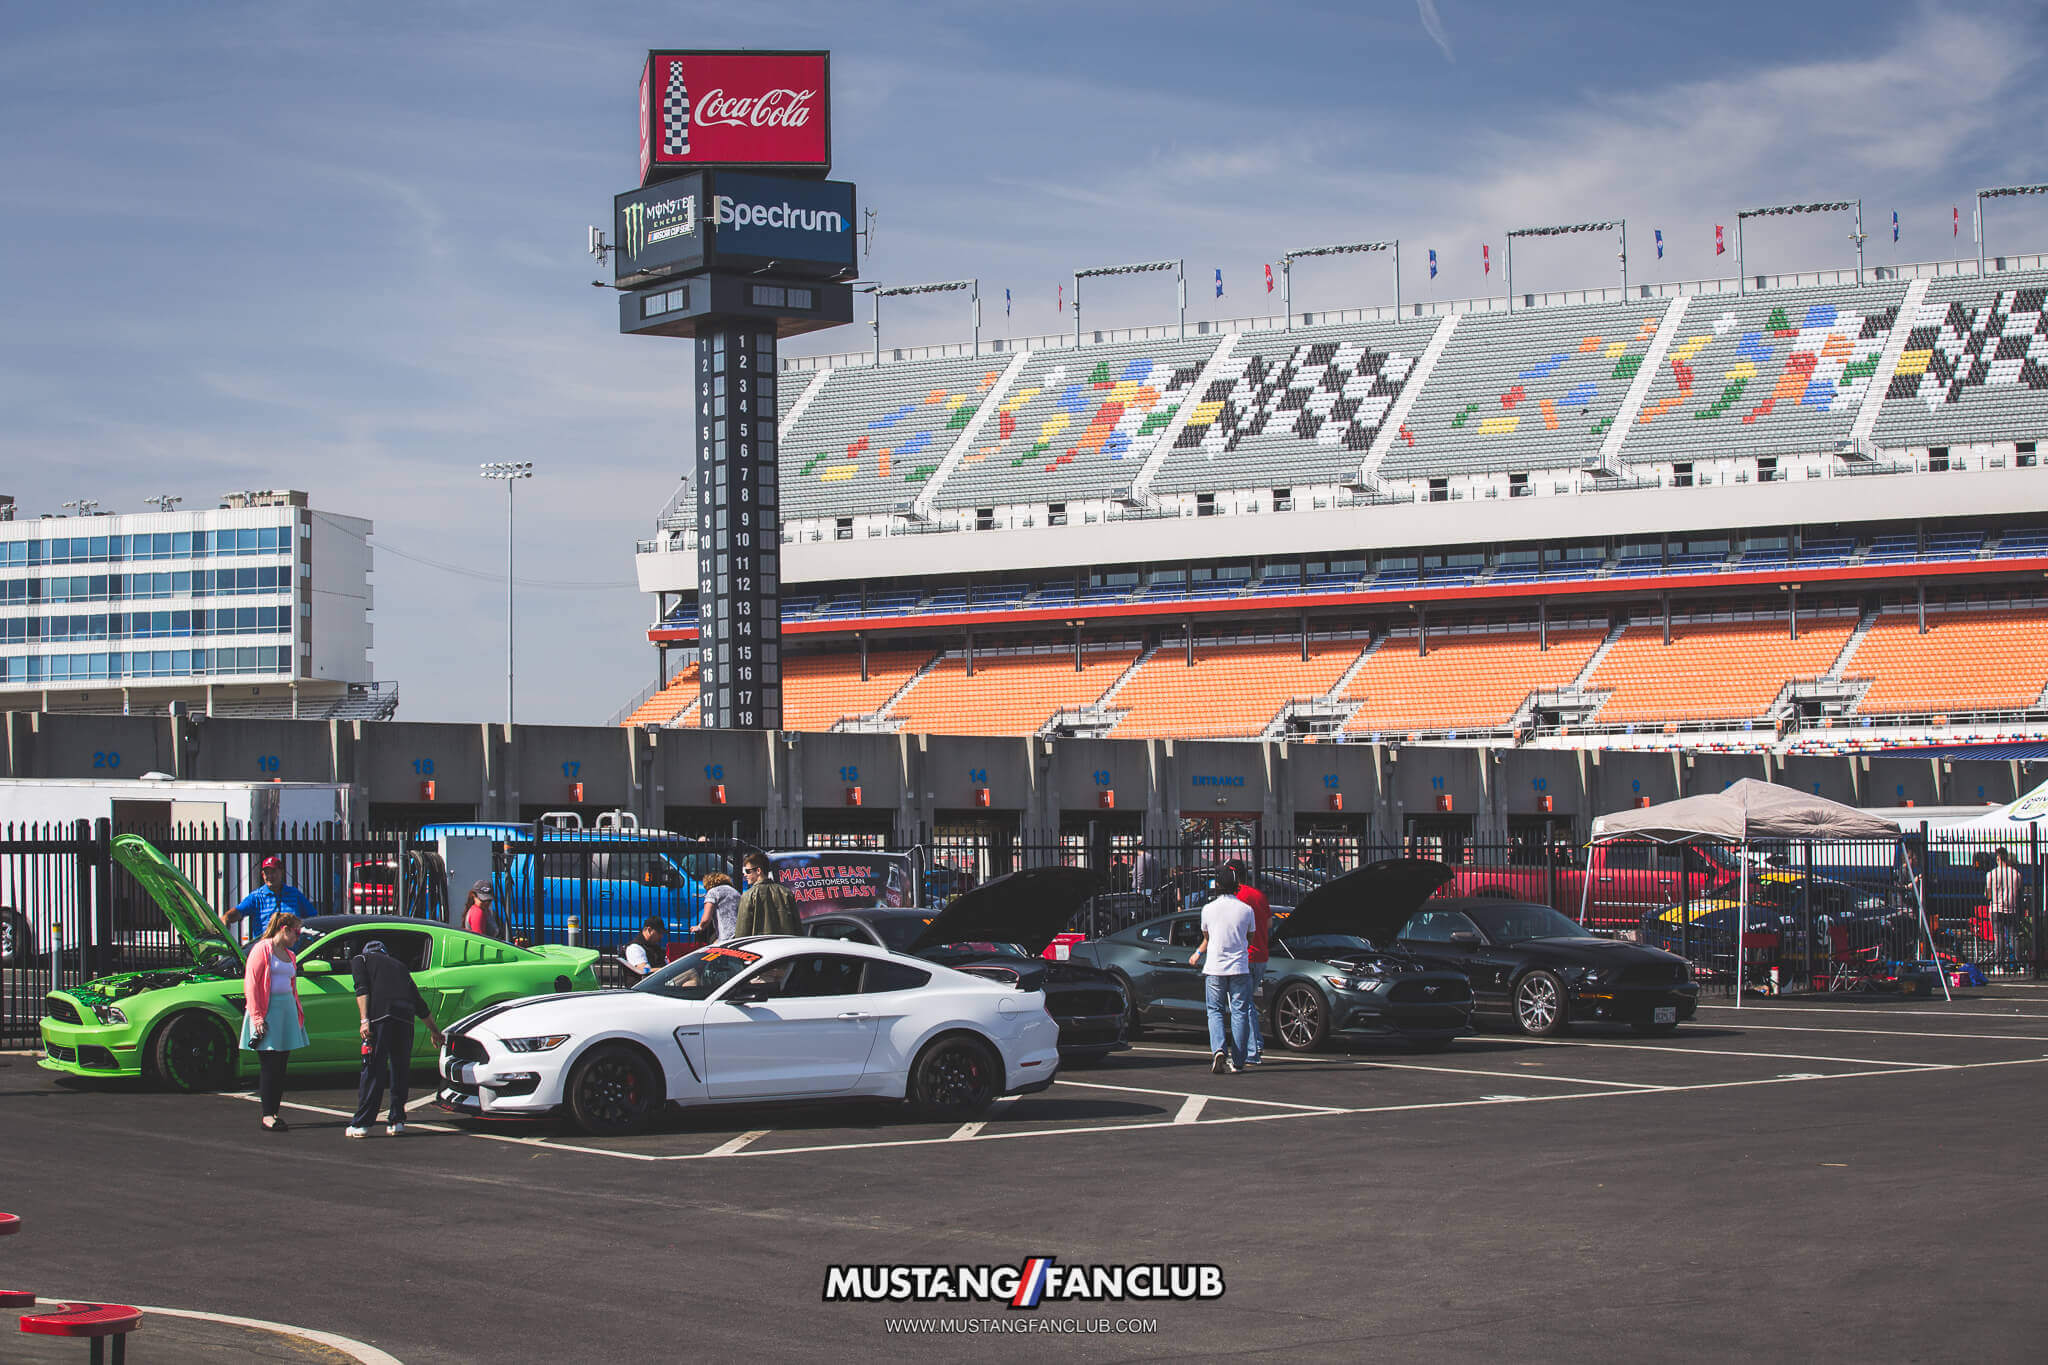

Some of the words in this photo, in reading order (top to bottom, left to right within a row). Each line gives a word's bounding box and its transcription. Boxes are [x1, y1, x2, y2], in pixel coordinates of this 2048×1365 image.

[694, 88, 817, 127] Coca-Cola
[646, 196, 694, 219] MONSTE
[718, 195, 842, 233] Spectrum
[739, 335, 745, 348] 1
[702, 359, 708, 372] 2
[739, 355, 747, 369] 2
[702, 382, 709, 396] 3
[739, 379, 747, 393] 3
[702, 402, 708, 416] 4
[739, 399, 748, 413] 4
[703, 426, 709, 440] 5
[740, 423, 748, 437] 5
[703, 446, 709, 461] 6
[740, 443, 748, 457] 6
[704, 470, 710, 485] 7
[741, 468, 748, 481] 7
[704, 490, 710, 505] 8
[741, 488, 749, 502] 8
[704, 514, 710, 529] 9
[741, 512, 749, 526] 9
[700, 535, 711, 549] 10
[735, 532, 750, 547] 10
[700, 559, 711, 573] 11
[735, 557, 749, 570] 11
[701, 579, 712, 594] 12
[736, 577, 751, 591] 12
[701, 603, 712, 617] 13
[736, 601, 751, 615] 13
[702, 624, 712, 638] 14
[737, 622, 751, 635] 14
[702, 648, 713, 662] 15
[737, 646, 752, 660] 15
[702, 668, 713, 682] 16
[737, 666, 752, 681] 16
[703, 692, 713, 707] 17
[738, 691, 752, 705] 17
[703, 713, 714, 727] 18
[738, 711, 753, 725] 18
[93, 751, 121, 768] 20
[257, 755, 280, 772] 19
[412, 758, 435, 775] 18
[561, 761, 581, 777] 17
[704, 765, 724, 780] 16
[839, 766, 859, 782] 15
[969, 768, 987, 783] 14
[1093, 770, 1111, 785] 13
[1192, 775, 1246, 787] ENTRANCE
[1323, 774, 1340, 788] 12
[1432, 776, 1444, 789] 11
[1531, 777, 1547, 791] 10
[780, 866, 820, 882] MAKE
[823, 866, 837, 878] IT
[838, 866, 872, 878] EASY
[794, 881, 805, 889] SO
[807, 878, 849, 888] CUSTOMERS
[792, 887, 825, 902] AKE
[827, 887, 840, 899] IT
[842, 885, 878, 897] EASY
